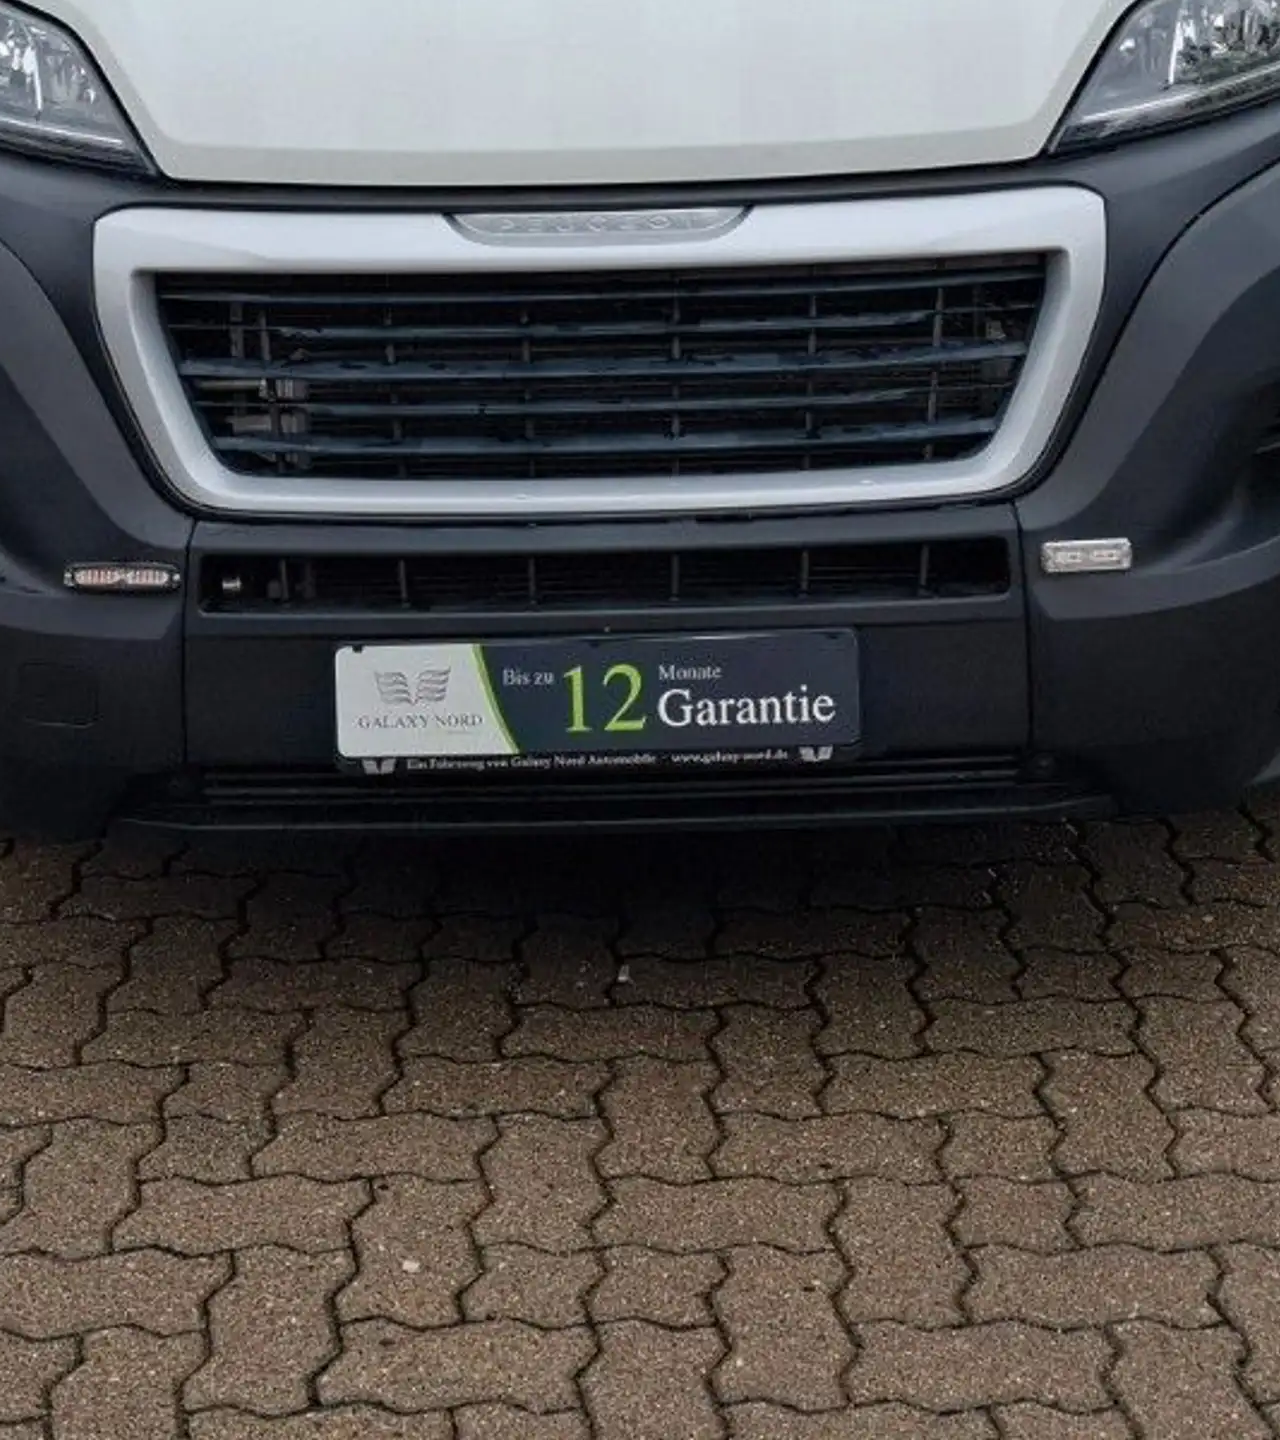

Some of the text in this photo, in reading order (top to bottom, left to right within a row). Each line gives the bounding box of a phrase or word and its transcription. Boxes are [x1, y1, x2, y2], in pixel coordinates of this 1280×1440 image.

[658, 664, 723, 680] Monate
[503, 663, 647, 732] Bis zu 12
[657, 684, 837, 727] Garantie
[356, 713, 483, 730] GALAXY NORD
